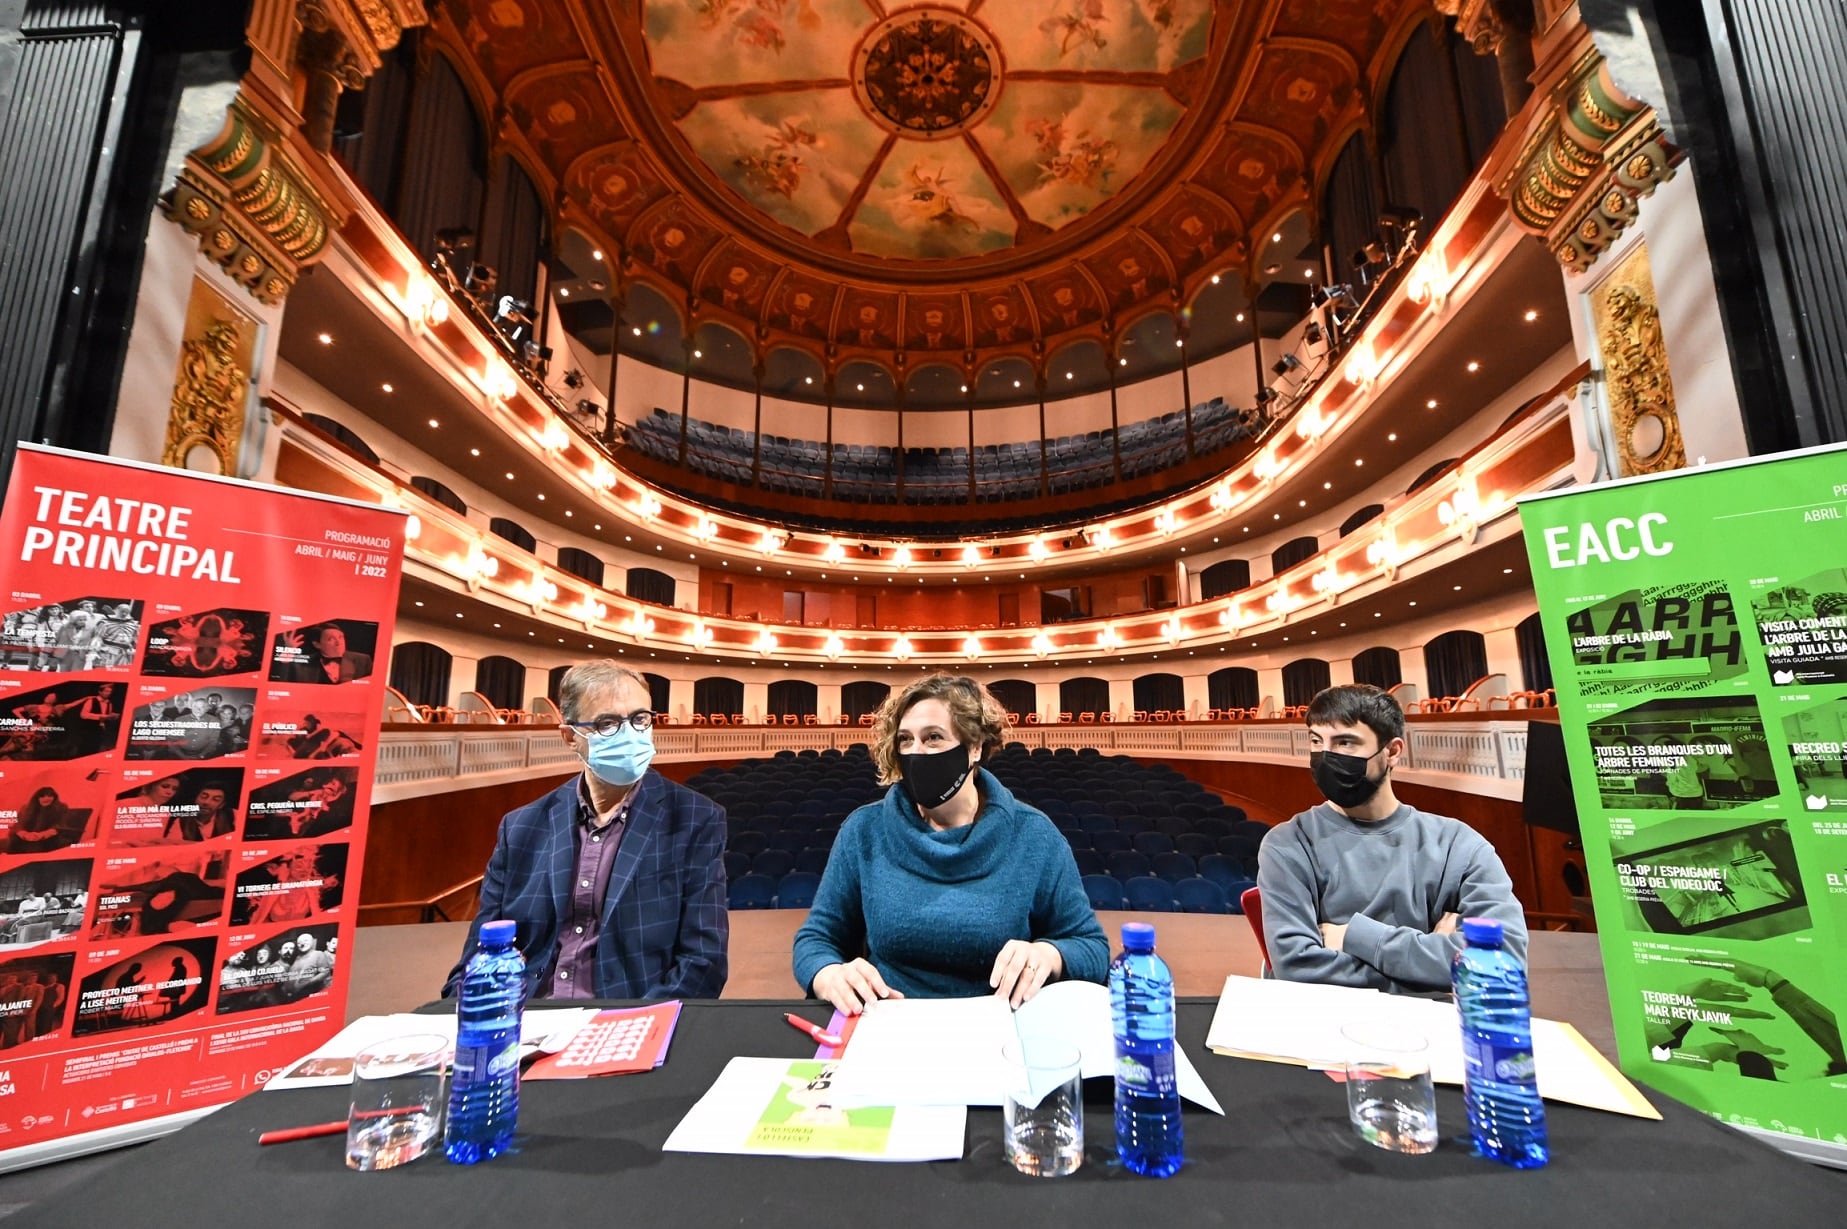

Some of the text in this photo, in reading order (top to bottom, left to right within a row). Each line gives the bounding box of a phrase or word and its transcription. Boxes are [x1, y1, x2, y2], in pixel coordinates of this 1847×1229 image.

[33, 486, 191, 540] TEATRE
[1804, 507, 1843, 523] ABRIL
[324, 530, 391, 550] PROGRAMACIÓ
[1543, 512, 1674, 568] EACC
[21, 525, 240, 583] PRINCIPAL
[294, 543, 324, 558] ABRIL
[332, 548, 356, 562] MAIG
[364, 552, 389, 566] JUNY
[361, 564, 387, 577] 2022
[1761, 620, 1799, 633] VISITA
[1574, 629, 1674, 648] L'ARBRE DE LA RÀBIA
[1764, 632, 1812, 646] L'ARBRE
[1812, 629, 1831, 642] DE
[1768, 644, 1796, 658] AMB
[1796, 642, 1832, 656] JULIA
[1793, 655, 1820, 663] GUIADA
[1594, 743, 1733, 757] TOTES LES BRANQUES D'UN
[1792, 742, 1841, 755] RECREO
[1597, 756, 1688, 769] ARBRE FEMINISTA
[1617, 863, 1722, 880] CO-OP ESPAIGAME
[1826, 873, 1843, 886] EL
[1619, 876, 1724, 892] CLUB DEL VIDEOJOC
[79, 993, 139, 1009] A LISE MEITNER
[82, 987, 121, 1001] PROYECTO
[1641, 989, 1698, 1008] TEOREMA:
[1644, 1004, 1734, 1026] MAR REYKJAVIK
[1646, 1017, 1672, 1025] TALLER
